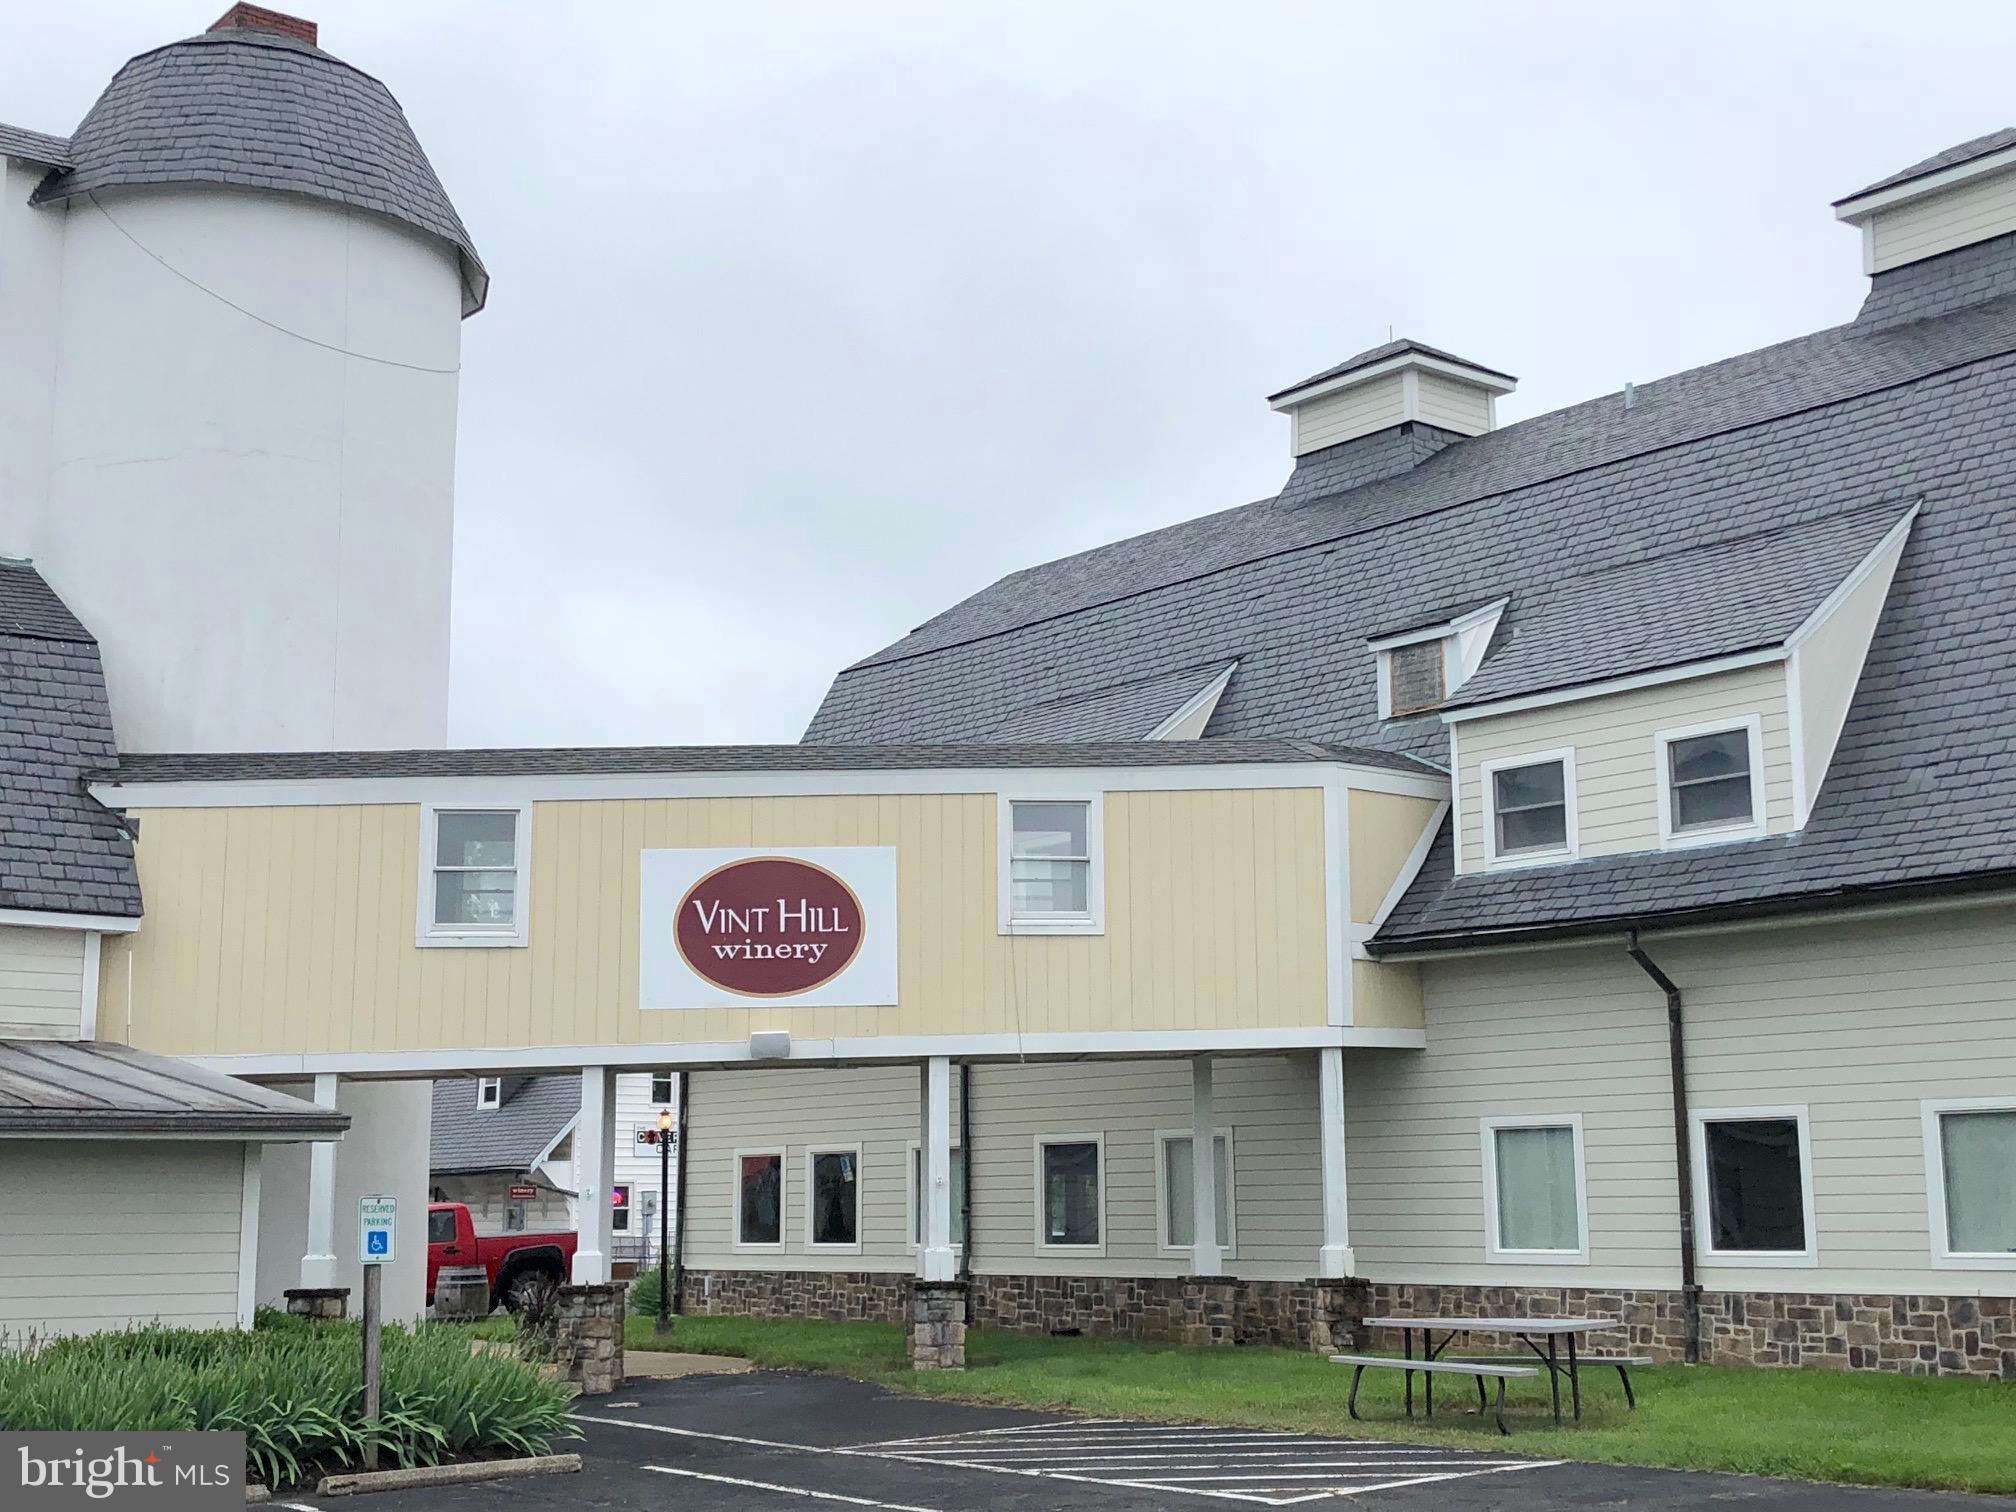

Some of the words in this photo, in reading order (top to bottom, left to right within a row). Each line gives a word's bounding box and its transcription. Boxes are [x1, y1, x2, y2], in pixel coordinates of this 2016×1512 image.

[692, 899, 769, 934] VINT
[777, 898, 849, 933] HILL
[712, 938, 828, 964] winery
[362, 1204, 395, 1214] RESERVED
[363, 1217, 393, 1226] PARKING
